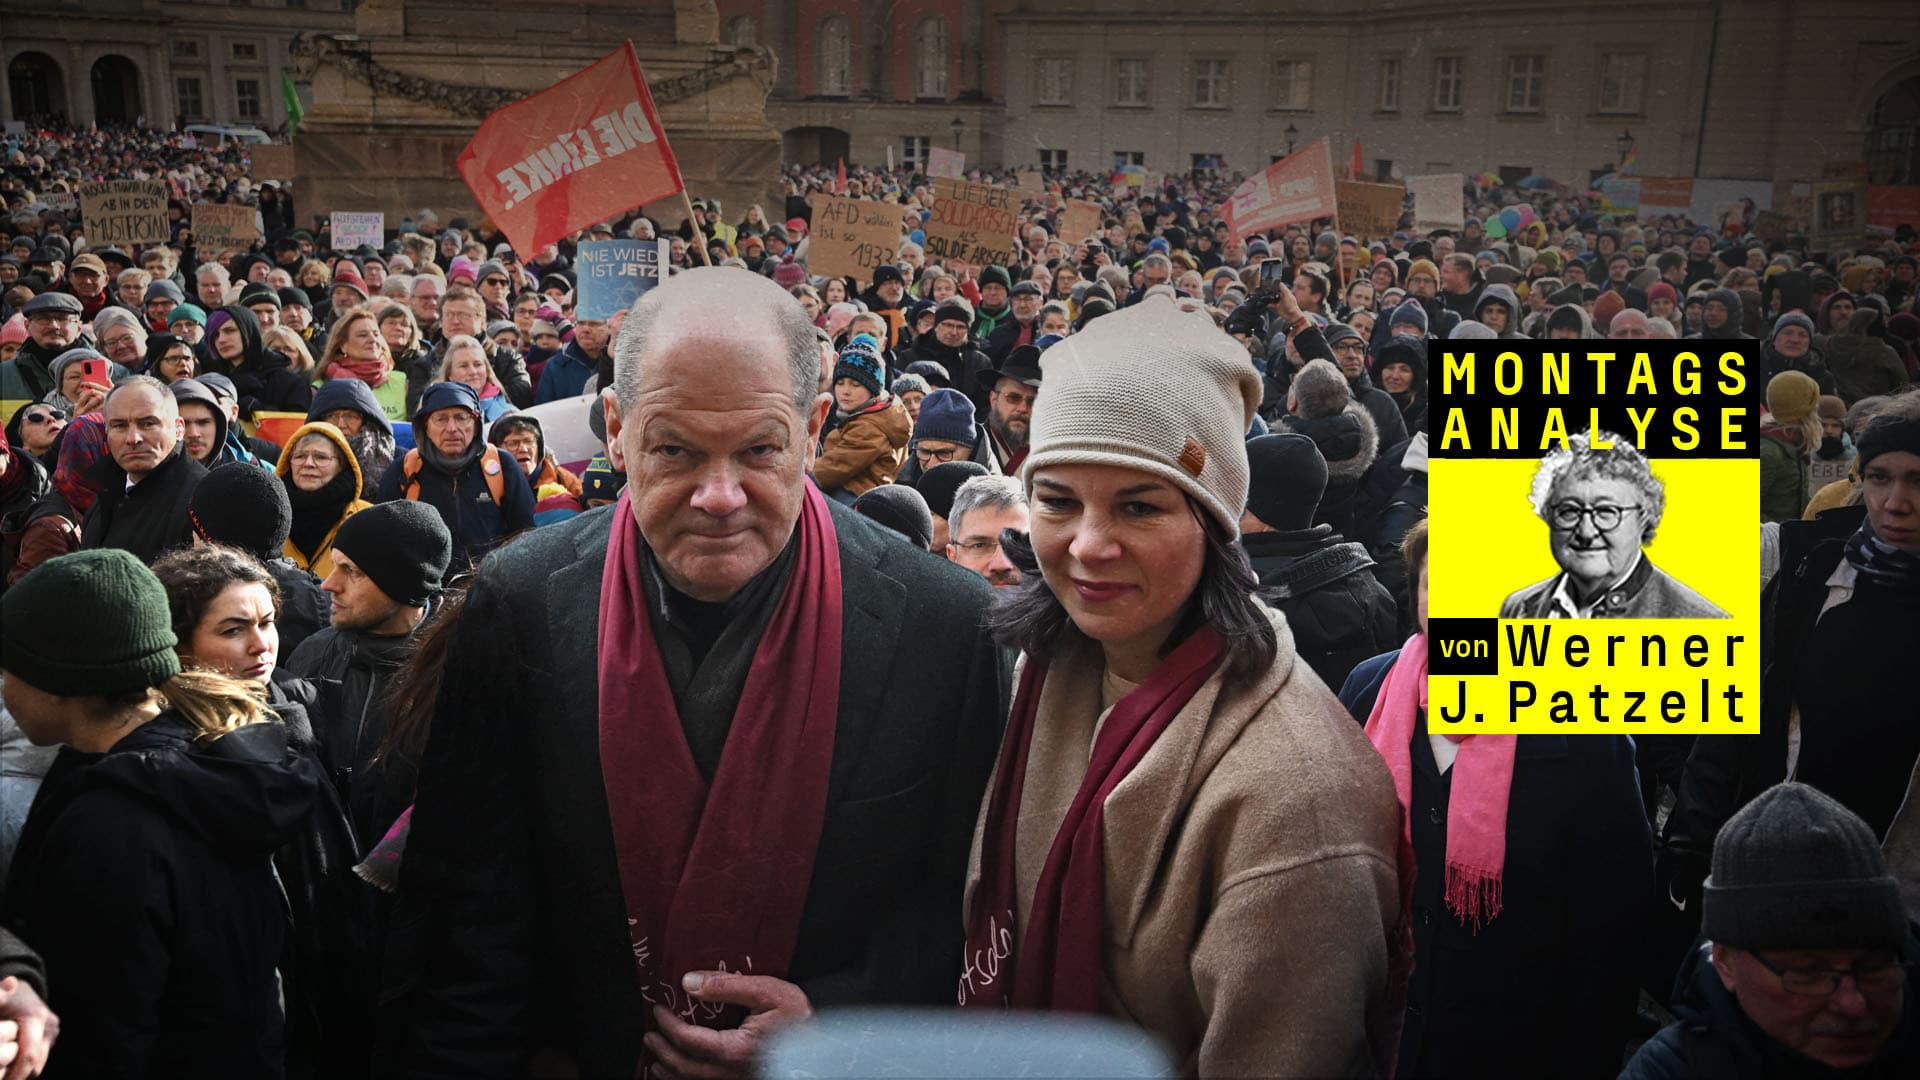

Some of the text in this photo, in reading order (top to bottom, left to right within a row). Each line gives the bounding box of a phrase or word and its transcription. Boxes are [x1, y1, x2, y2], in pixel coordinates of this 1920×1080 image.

[100, 199, 117, 211] AB
[134, 198, 159, 209] DEN
[952, 183, 1009, 210] LIEBER
[822, 203, 859, 225] AfD
[931, 199, 1017, 236] SOLIDARISCH
[820, 225, 856, 242] ist so
[957, 231, 977, 243] ALS
[582, 248, 658, 263] NIE WIED
[851, 244, 894, 269] 1933
[592, 263, 658, 278] IST JETZ
[1811, 463, 1852, 478] EBE
